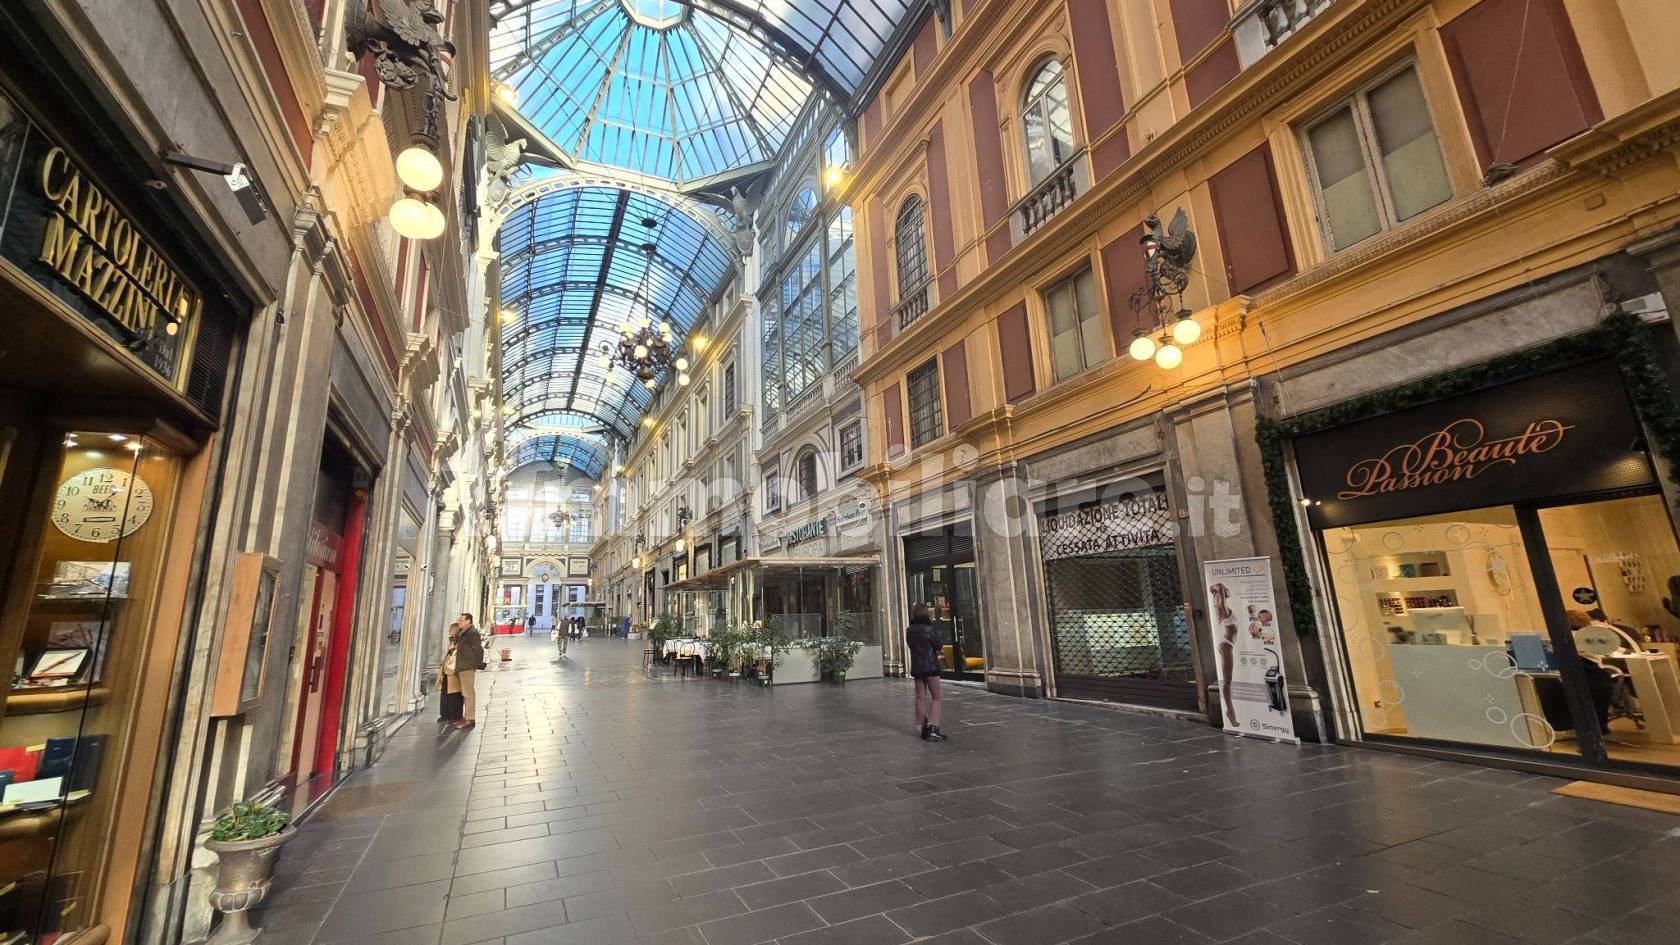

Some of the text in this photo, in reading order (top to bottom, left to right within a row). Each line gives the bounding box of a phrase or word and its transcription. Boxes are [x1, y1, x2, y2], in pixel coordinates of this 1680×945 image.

[43, 147, 188, 323] CARTOLERIA
[39, 212, 158, 338] MAZZINI
[99, 473, 113, 483] 12
[1338, 446, 1515, 500] Passion
[82, 476, 93, 486] 11
[66, 486, 80, 496] 10
[134, 488, 143, 498] 2
[57, 499, 66, 509] 9
[60, 512, 70, 523] 8
[1041, 504, 1120, 533] LIQUIDAZIONE
[73, 523, 84, 533] 7
[91, 527, 100, 538] 6
[1056, 539, 1100, 555] CESSATA
[1211, 566, 1251, 576] UNLIMITED
[1262, 723, 1290, 734] Sinergy
